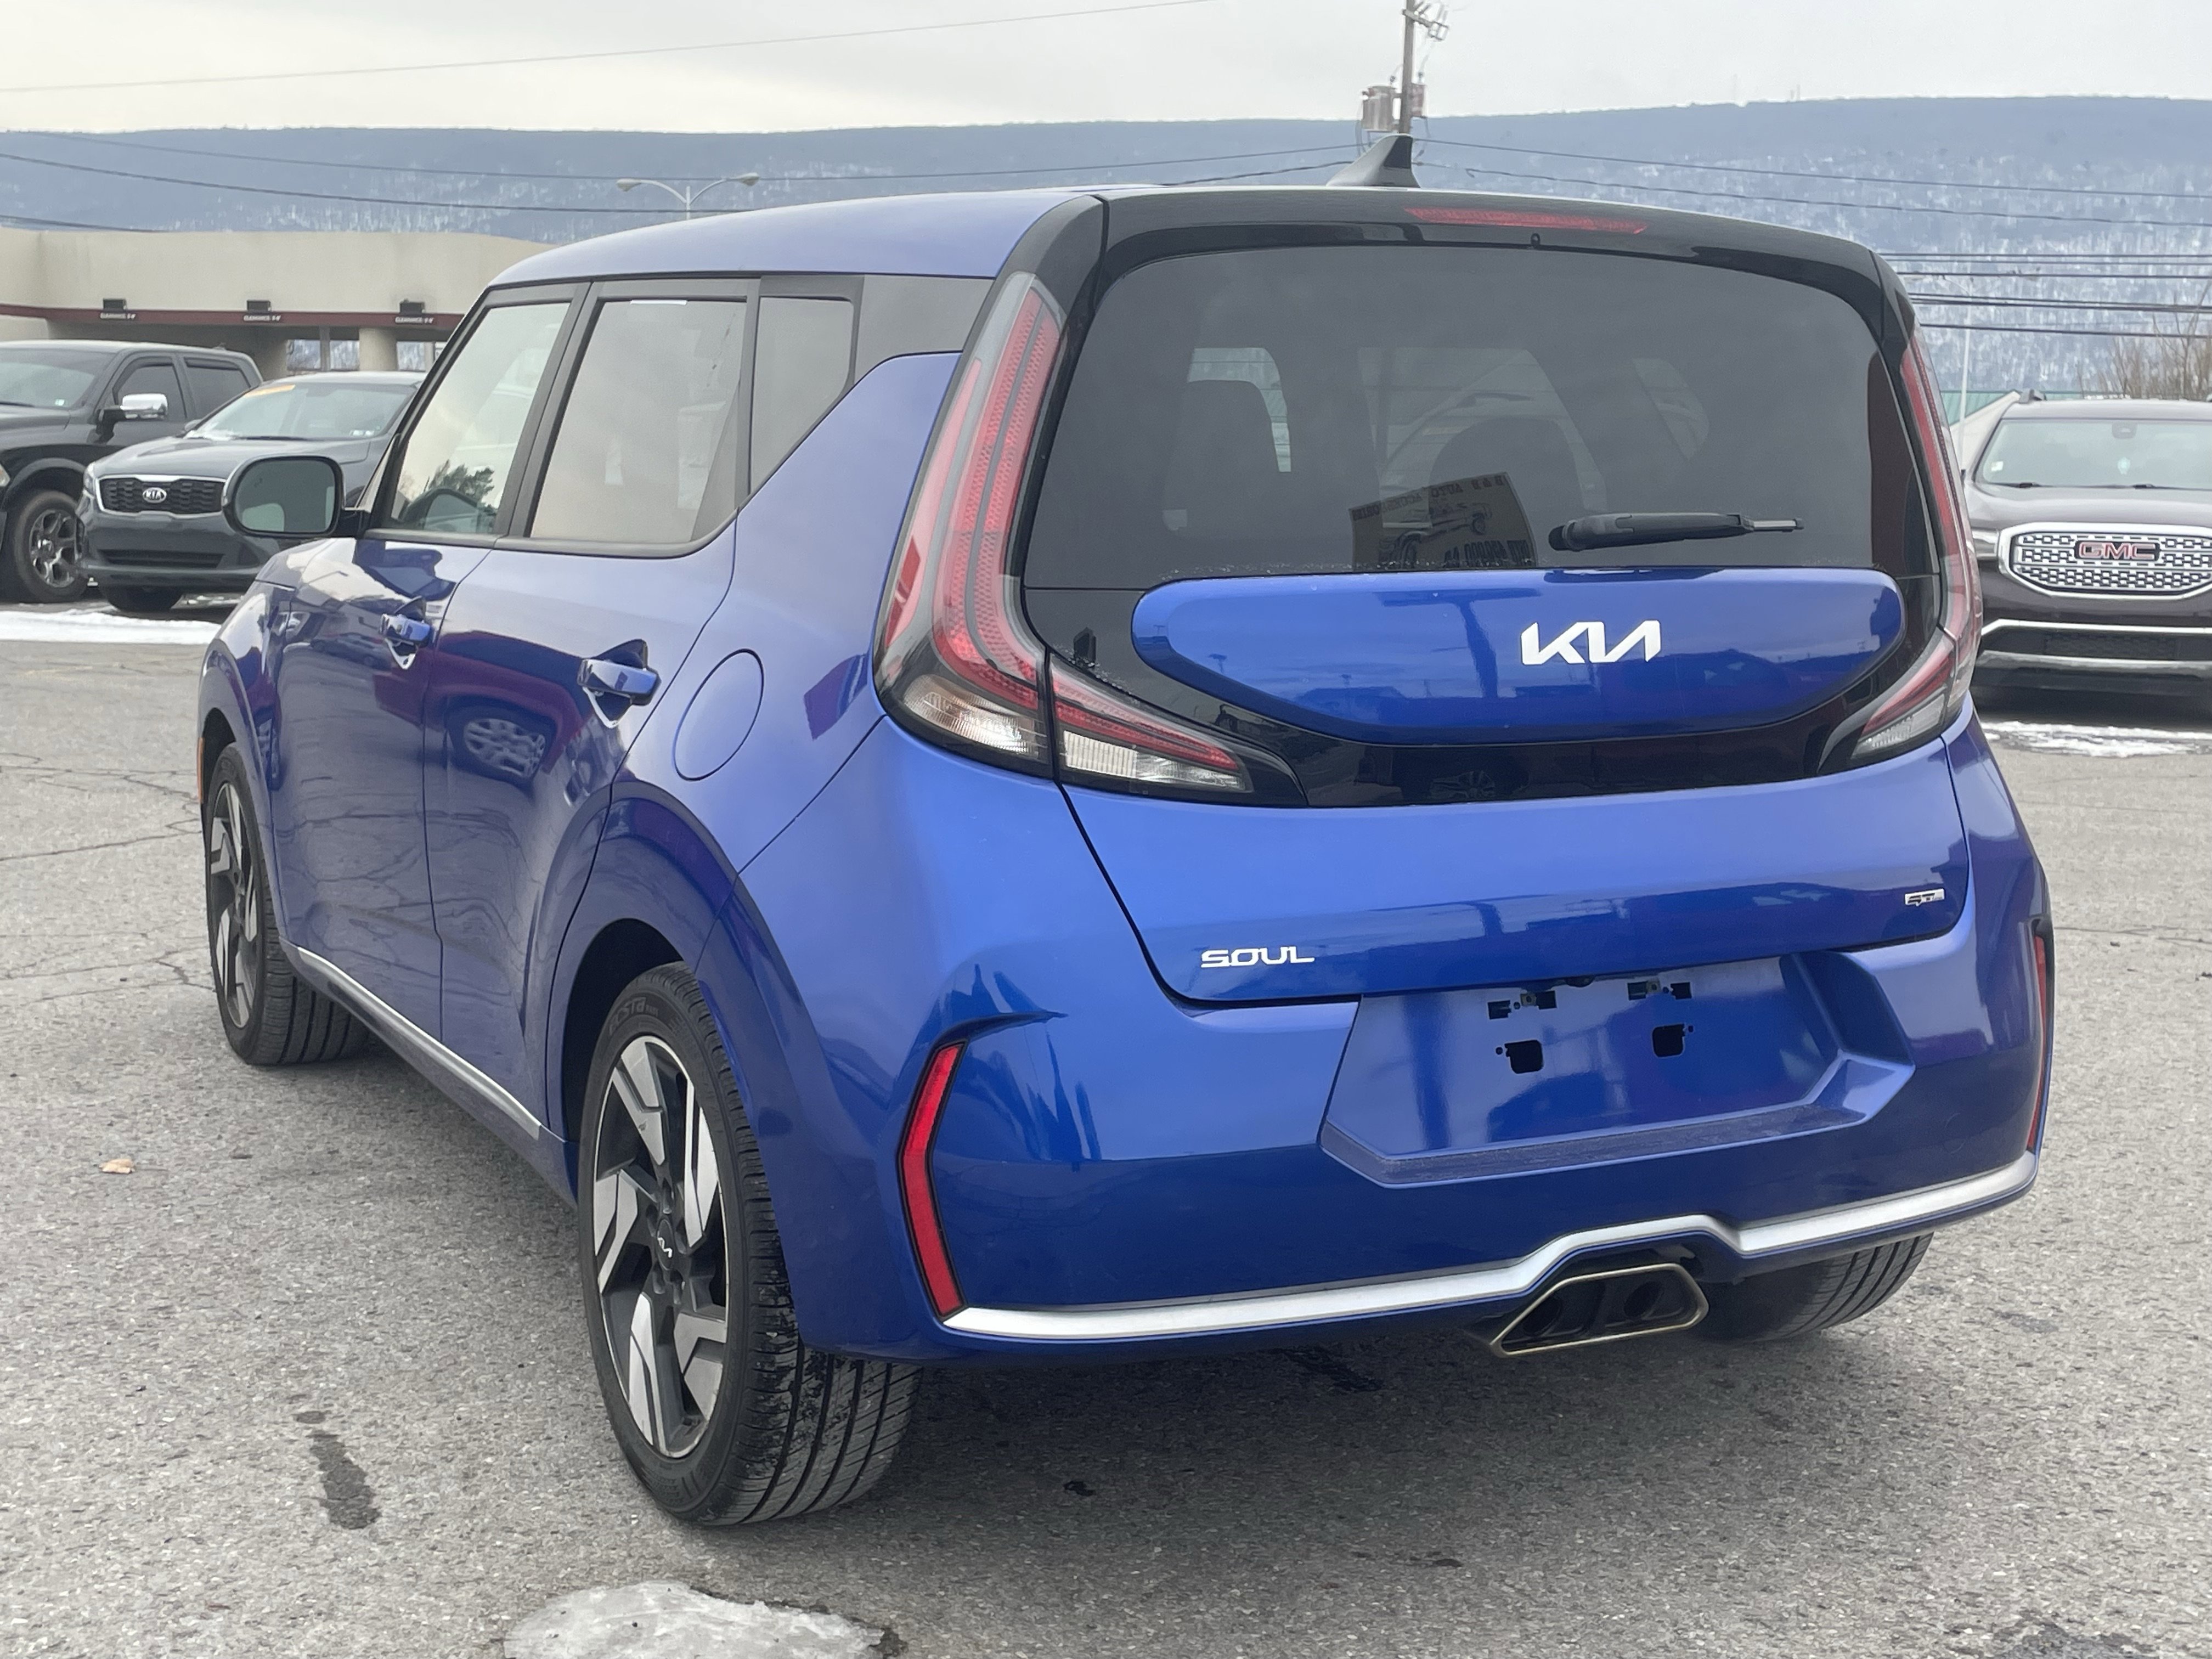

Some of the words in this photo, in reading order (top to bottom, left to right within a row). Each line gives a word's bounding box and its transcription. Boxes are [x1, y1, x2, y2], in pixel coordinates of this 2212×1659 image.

[2079, 541, 2156, 560] GMC
[1521, 619, 1661, 665] KIA
[1201, 946, 1315, 968] SOUL
